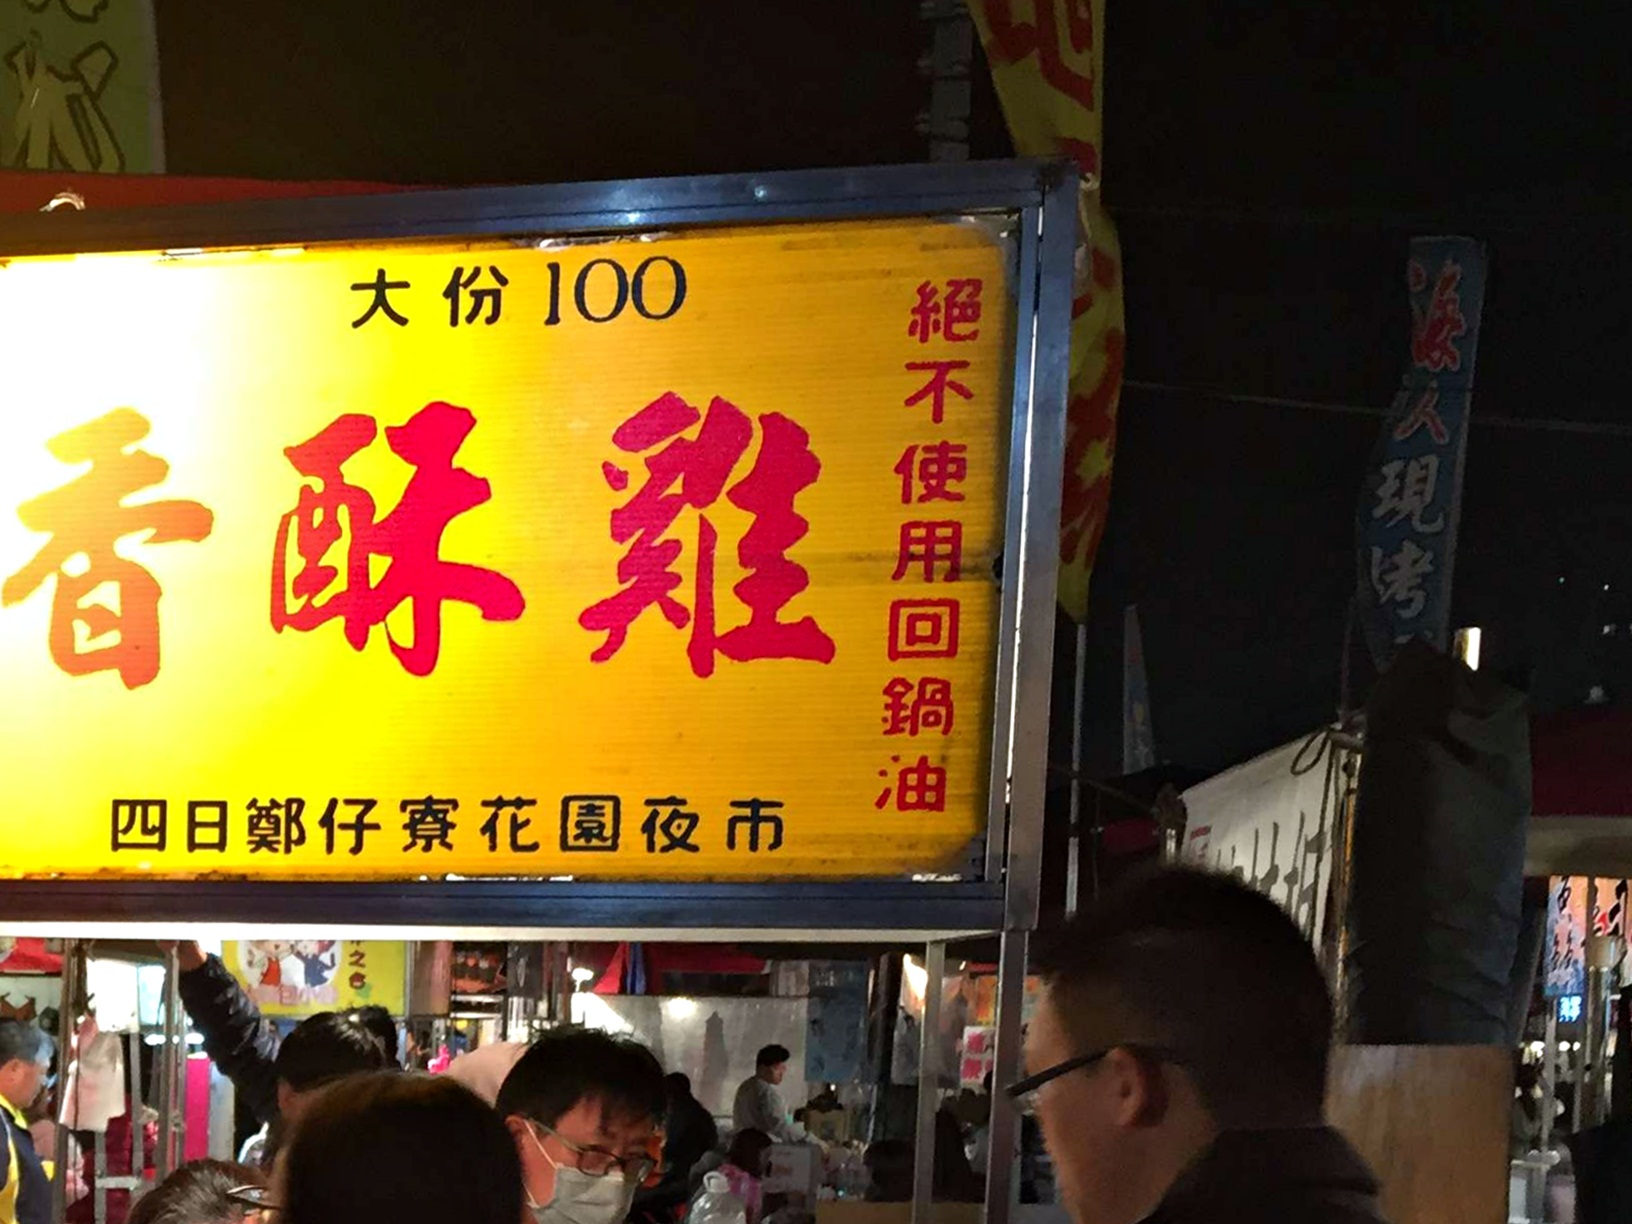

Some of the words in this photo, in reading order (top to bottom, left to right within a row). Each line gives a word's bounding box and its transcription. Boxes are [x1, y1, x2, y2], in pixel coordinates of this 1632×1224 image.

[0, 389, 837, 692] 香酥雞
[874, 276, 984, 813] 絕不使用回鍋油
[110, 792, 786, 855] 四日鄭仔寮花園夜市
